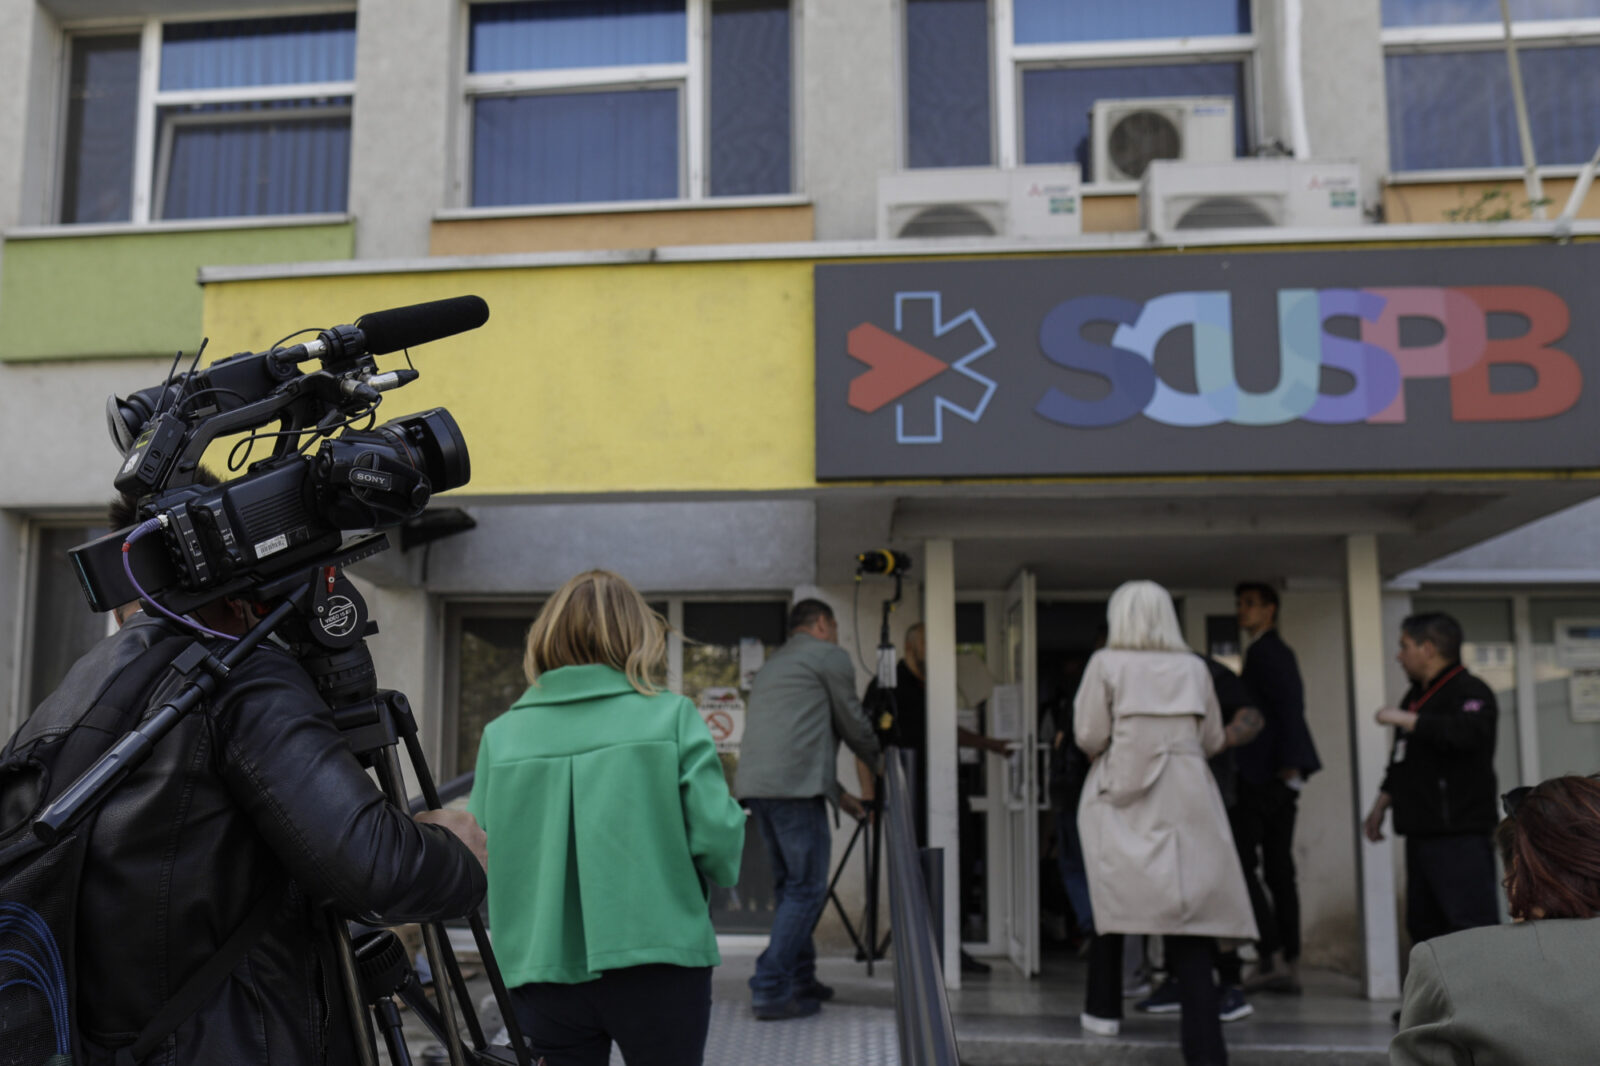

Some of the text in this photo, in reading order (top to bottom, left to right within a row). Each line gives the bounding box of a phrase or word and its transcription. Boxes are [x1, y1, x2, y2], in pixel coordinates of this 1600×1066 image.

[1033, 286, 1583, 428] SCUSPB
[357, 473, 386, 484] SONY
[324, 613, 340, 624] VIDEO
